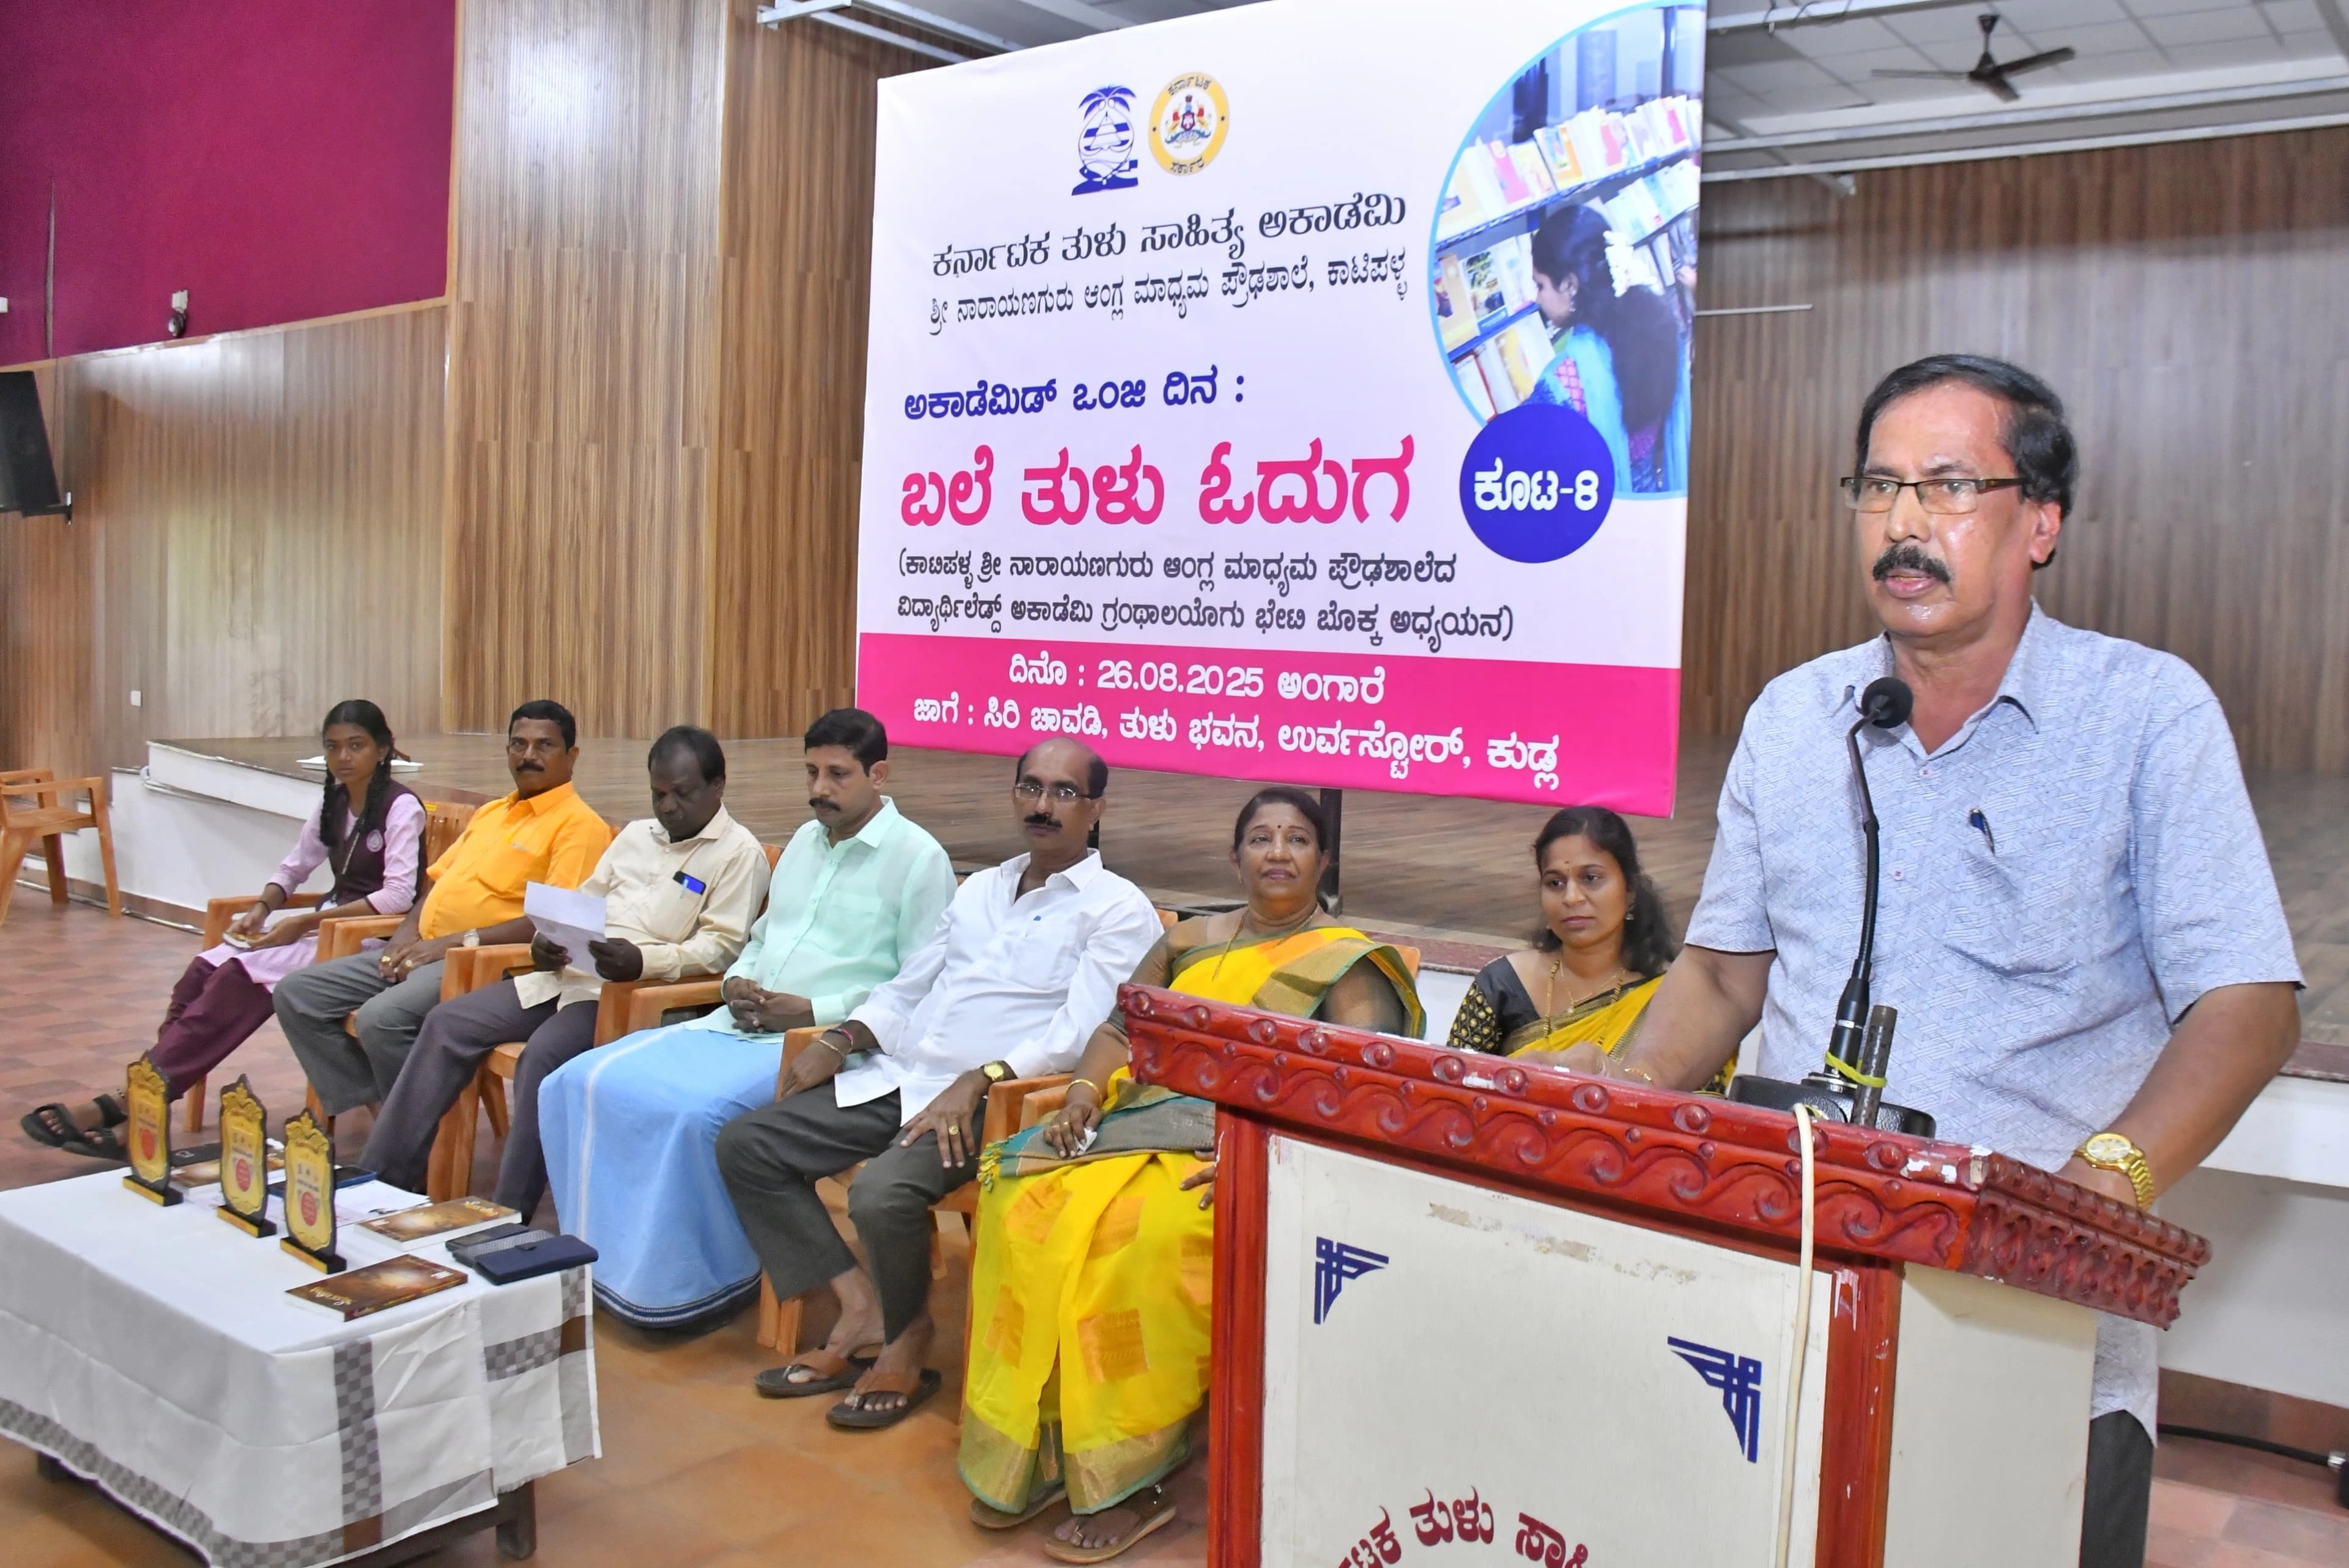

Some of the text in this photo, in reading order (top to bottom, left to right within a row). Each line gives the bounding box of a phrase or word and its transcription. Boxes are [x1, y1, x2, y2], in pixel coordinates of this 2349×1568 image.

[933, 192, 1406, 278] ಕರ್ನಾಟಕ ತುಳು ಸಾಹಿತ್ಯ ಅಕಾಡೆಮಿ
[929, 246, 1408, 336] ಶ್ರೀ ನಾರಾಯಣಗುರು ಆಂಗ್ಲ ಮಾಧ್ಯಮ ಪ್ರೌಢಶಾಲೆ, ಕಾಟಿಪಳ್ಳ
[905, 364, 1244, 420] ಅಕಾಡೆಮಿಡ್ ಒಂಜಿ ದಿನ :
[901, 434, 1414, 526] ಬಲೆ ತುಳು ಓದುಗ
[977, 551, 1001, 583] ಶ್ರೀ
[1009, 551, 1153, 578] ನಾರಾಯಣಗುರು
[1163, 551, 1215, 592] ಆಂಗ್ಲ
[1224, 551, 1317, 598] ಮಾಧ್ಯಮ
[1329, 550, 1457, 590] ಪ್ರೌಢಶಾಲೆದ
[1011, 594, 1093, 622] ಅಕಾಡೆಮಿ
[1101, 596, 1245, 631] ಗ್ರಂಥಾಲಯೊಗು
[1255, 598, 1305, 634] ಭೇಟಿ
[1317, 600, 1383, 646] ಬೊಕ್ಕ
[1390, 604, 1513, 653] ಅಧ್ಯಯನ)
[1078, 664, 1085, 686] :
[1097, 660, 1264, 697] 26.08.2025
[1277, 666, 1386, 704] ಅಂಗಾರೆ
[913, 691, 1559, 790] ಜಾಗೆ : ಸಿರಿ ಚಾವಡಿ, ತುಳು ಭವನ, ಉರ್ವಸ್ಟೋರ್, ಕುಡ್ಲ
[1409, 1485, 1494, 1547] ತುಳು
